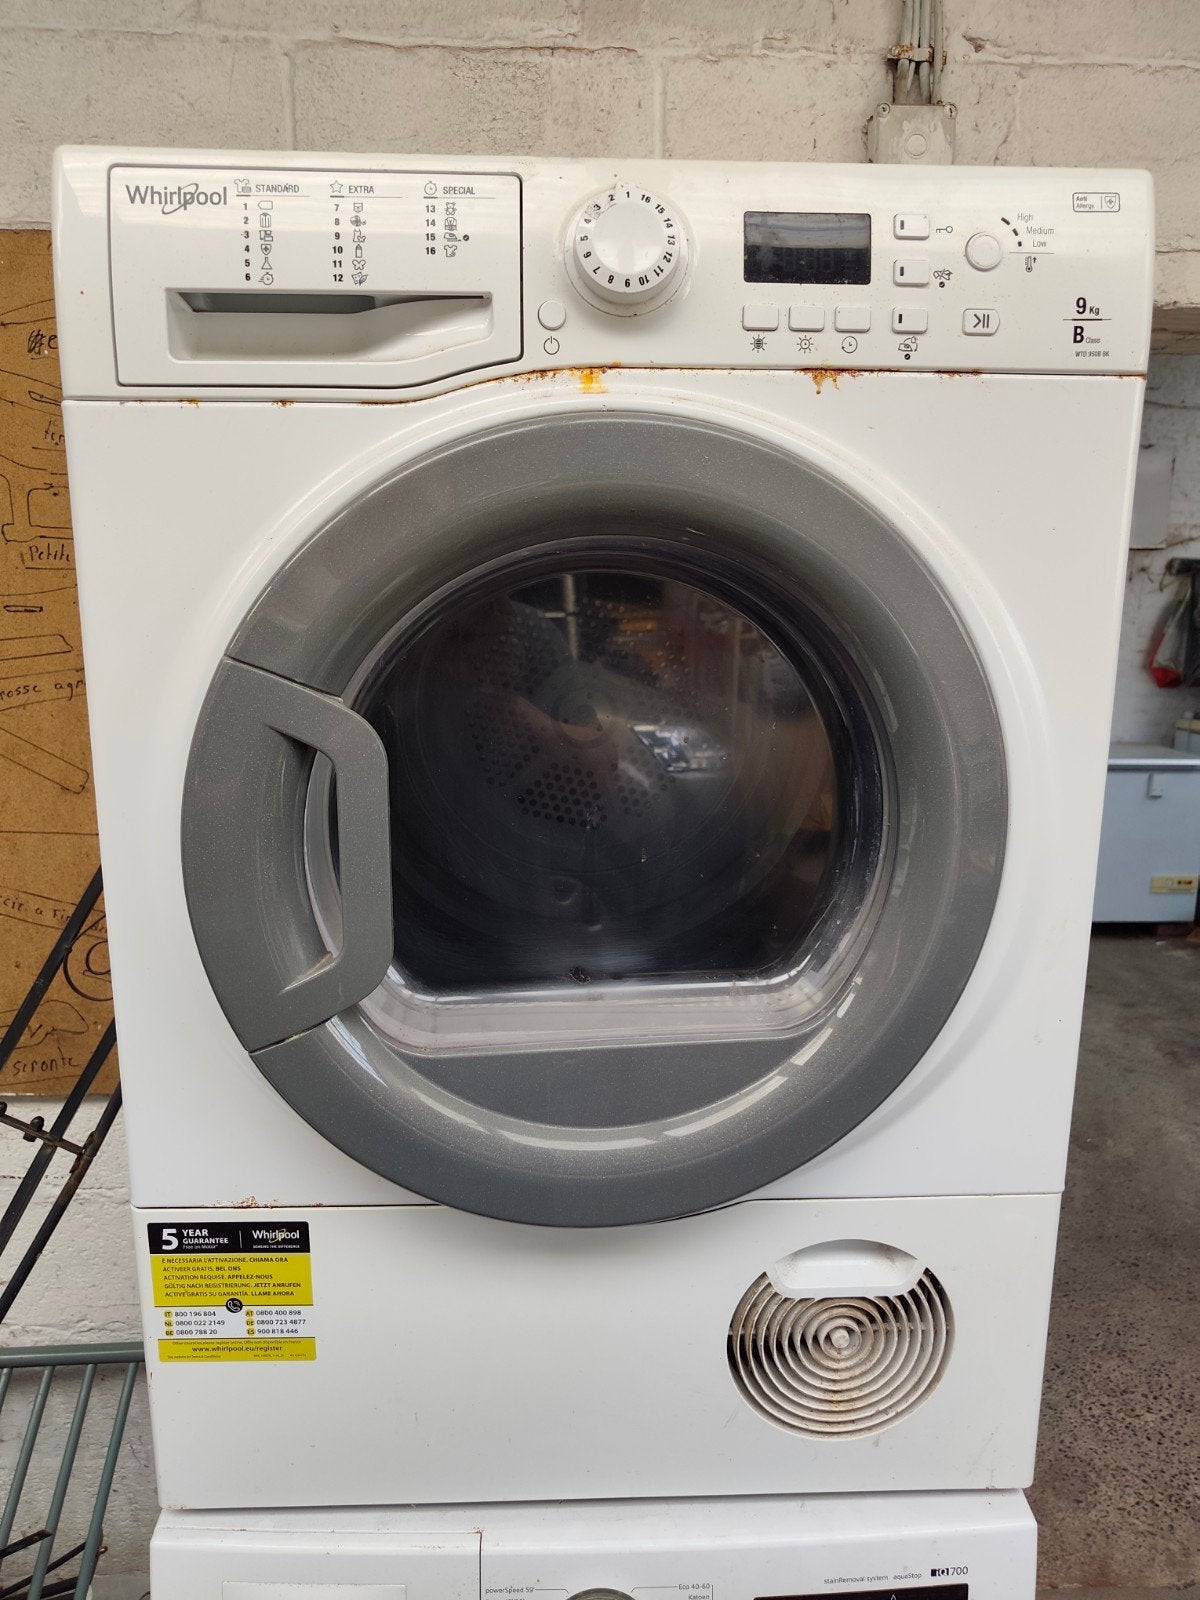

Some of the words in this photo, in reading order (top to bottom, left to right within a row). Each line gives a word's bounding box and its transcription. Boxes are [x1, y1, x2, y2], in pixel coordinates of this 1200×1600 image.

[255, 184, 300, 193] STANDARD
[348, 185, 374, 194] EXTRA
[443, 186, 476, 195] SPECIAL
[126, 184, 228, 212] Whirlpool
[641, 194, 651, 203] 16
[334, 204, 339, 212] 7
[425, 205, 436, 213] 13
[654, 204, 665, 214] 15
[244, 217, 249, 225] 2
[334, 218, 340, 226] 8
[1017, 213, 1033, 223] High
[425, 219, 436, 227] 14
[664, 218, 673, 228] 14
[244, 231, 250, 239] 3
[335, 232, 340, 240] 9
[425, 233, 436, 241] 15
[667, 235, 676, 246] 13
[1033, 240, 1047, 248] Low
[244, 245, 250, 253] 4
[332, 246, 343, 254] 10
[425, 247, 436, 255] 16
[663, 251, 672, 263] 12
[245, 259, 250, 267] 5
[332, 260, 343, 268] 11
[593, 266, 600, 274] 7
[654, 265, 664, 277] 11
[245, 273, 251, 281] 6
[333, 274, 344, 282] 12
[608, 274, 614, 284] 8
[638, 275, 650, 286] 10
[624, 278, 630, 287] 9
[1076, 297, 1086, 315] 9
[1089, 306, 1100, 316] Kg
[1073, 326, 1084, 343] B
[162, 1229, 179, 1250] 5
[252, 1229, 300, 1242] Whirlpool
[893, 1573, 922, 1581] aquaStop
